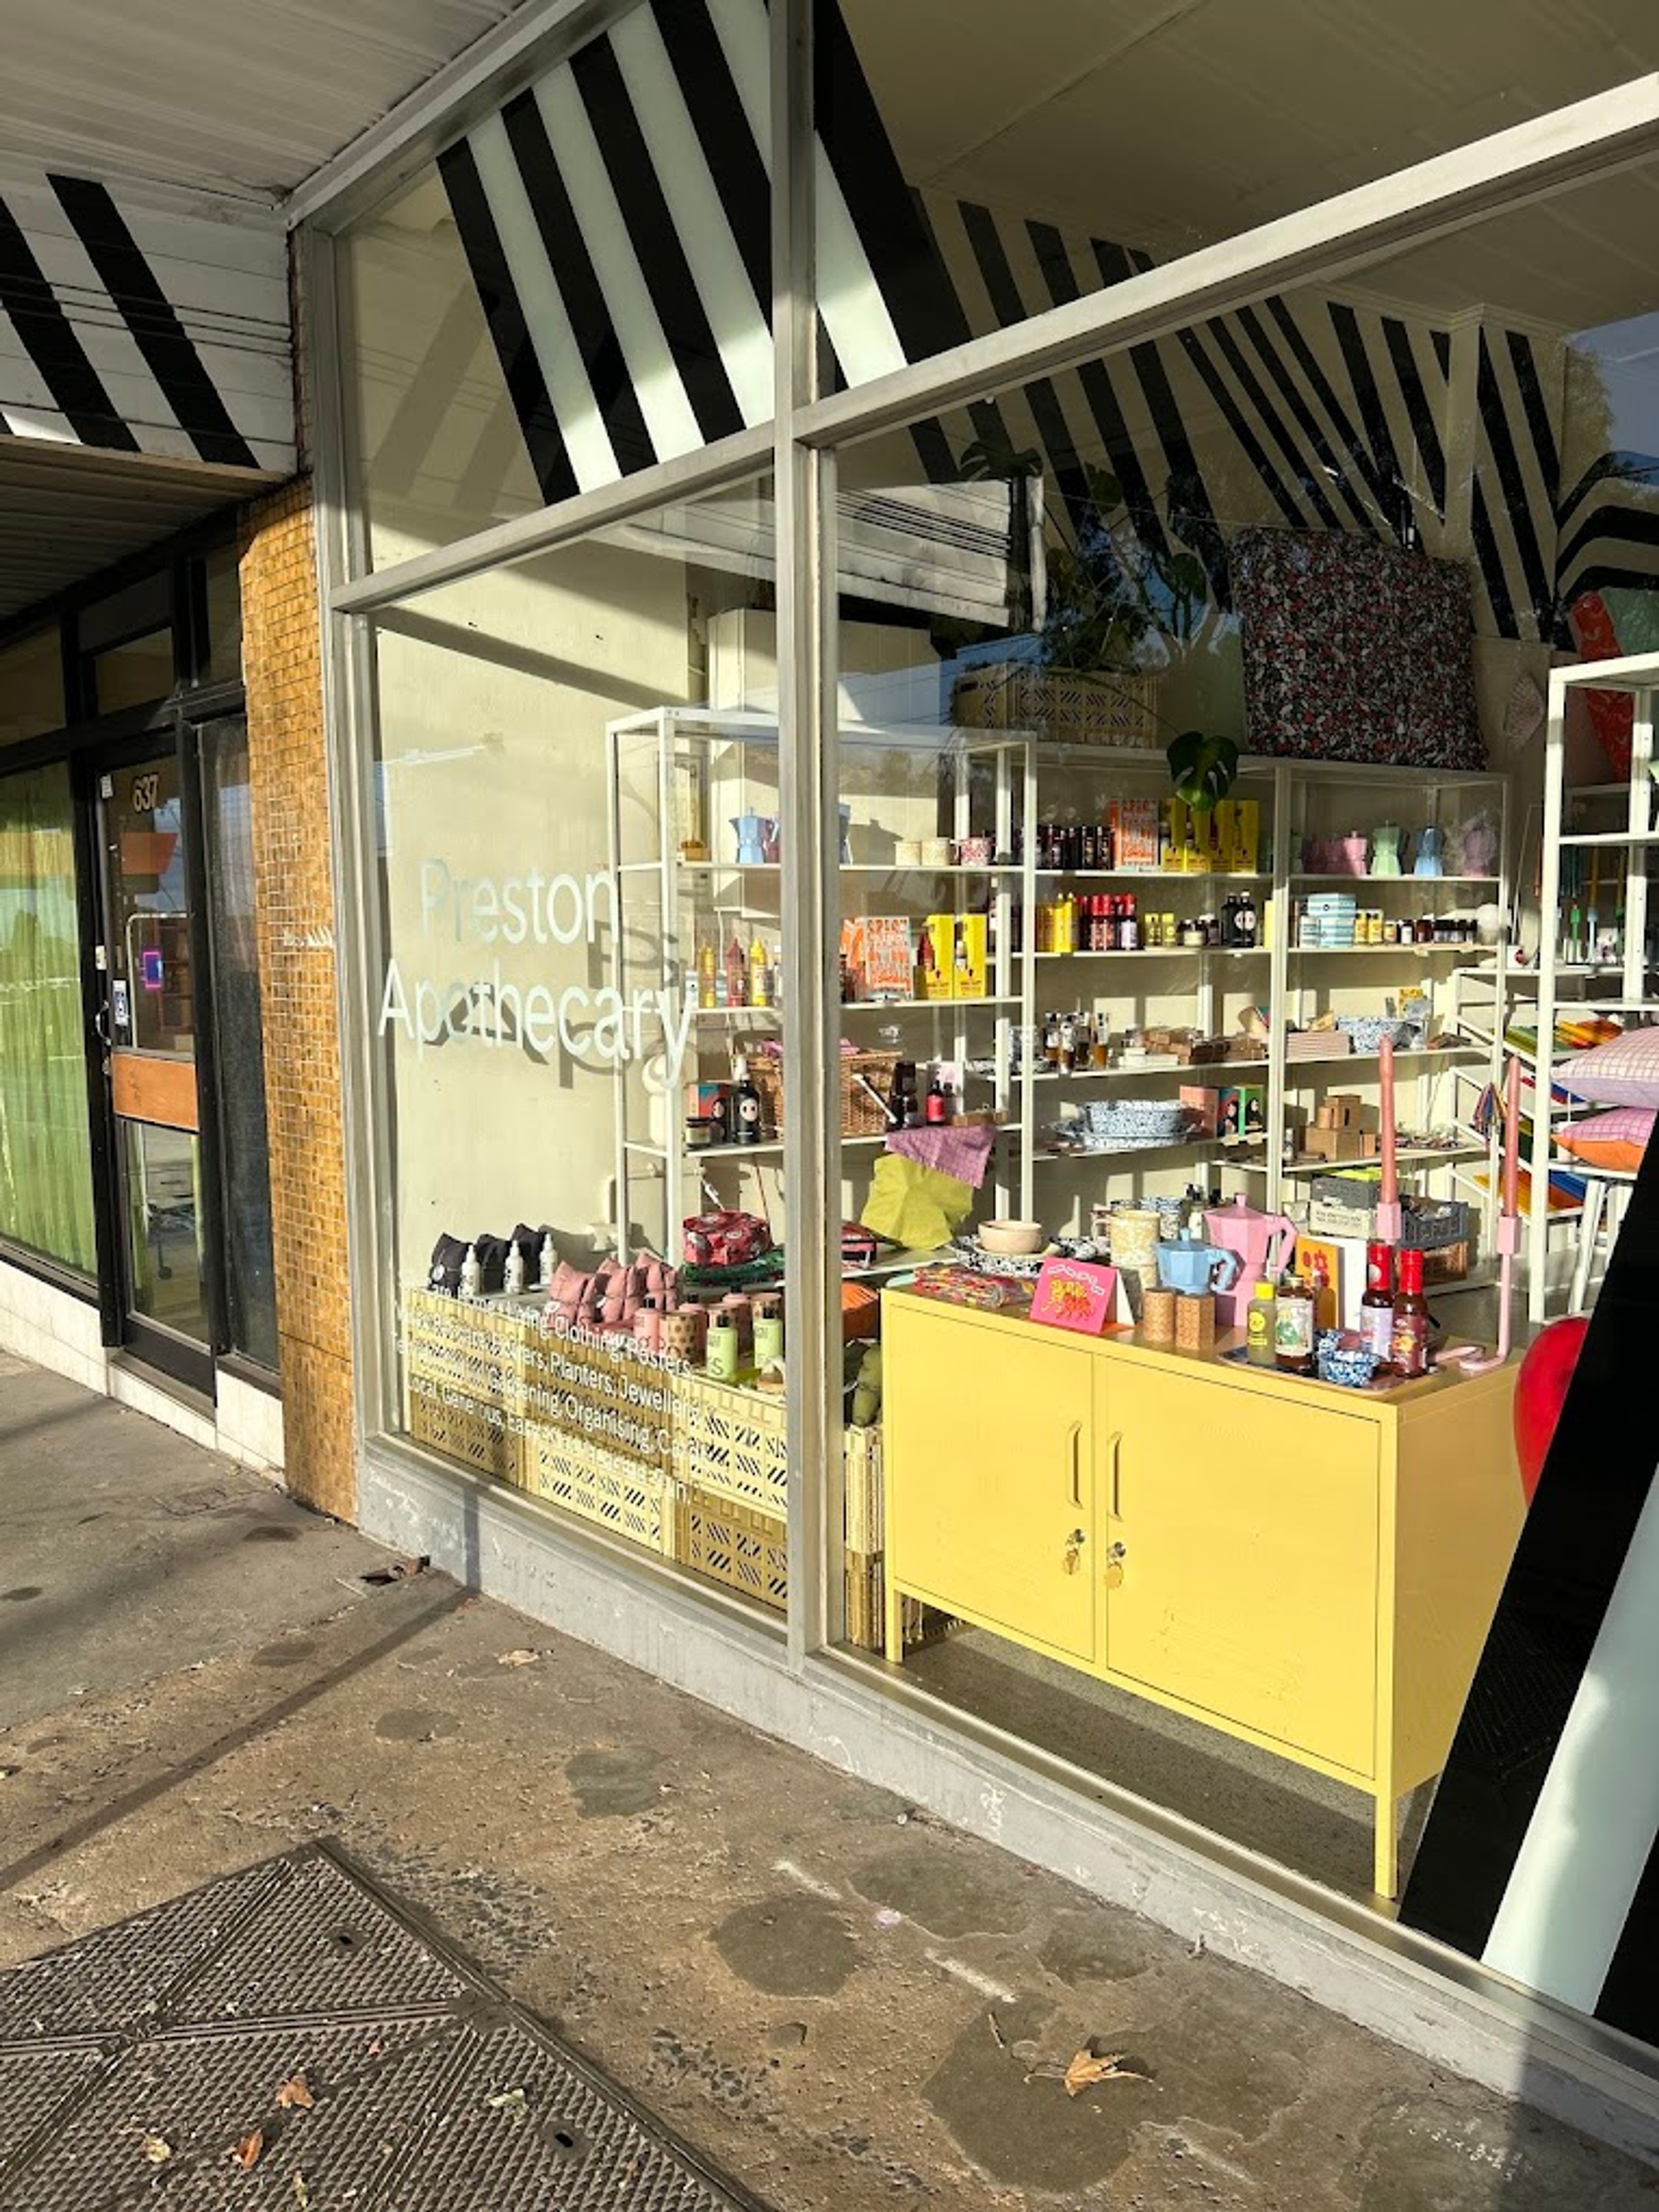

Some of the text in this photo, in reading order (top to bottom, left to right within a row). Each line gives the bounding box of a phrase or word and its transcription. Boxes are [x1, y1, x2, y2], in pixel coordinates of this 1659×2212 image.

[133, 773, 159, 812] 637
[421, 858, 619, 944] Preston
[378, 957, 692, 1090] Apothecary
